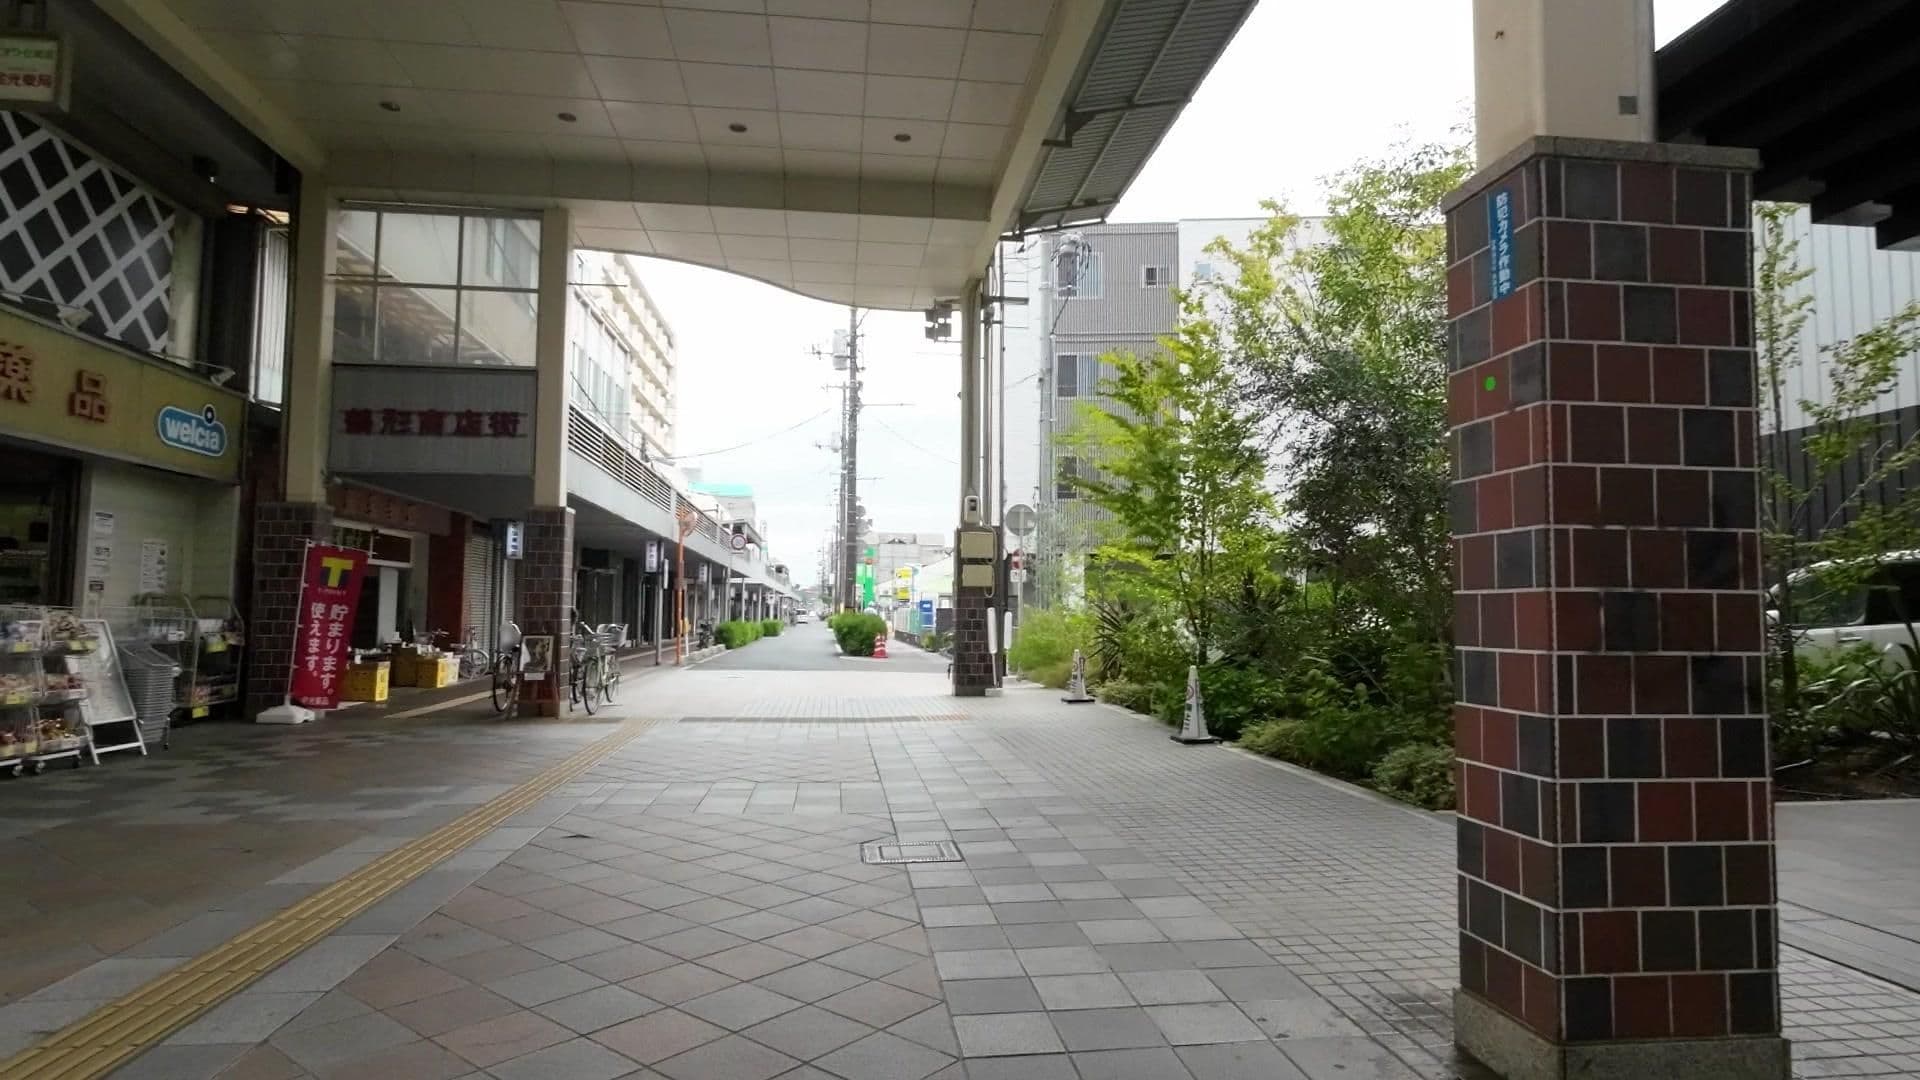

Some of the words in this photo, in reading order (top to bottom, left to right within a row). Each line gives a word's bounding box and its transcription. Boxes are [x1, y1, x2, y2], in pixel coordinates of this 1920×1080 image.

[164, 406, 221, 452] welcia
[305, 602, 327, 678] 使えます。
[320, 603, 349, 694] 貯まります。
